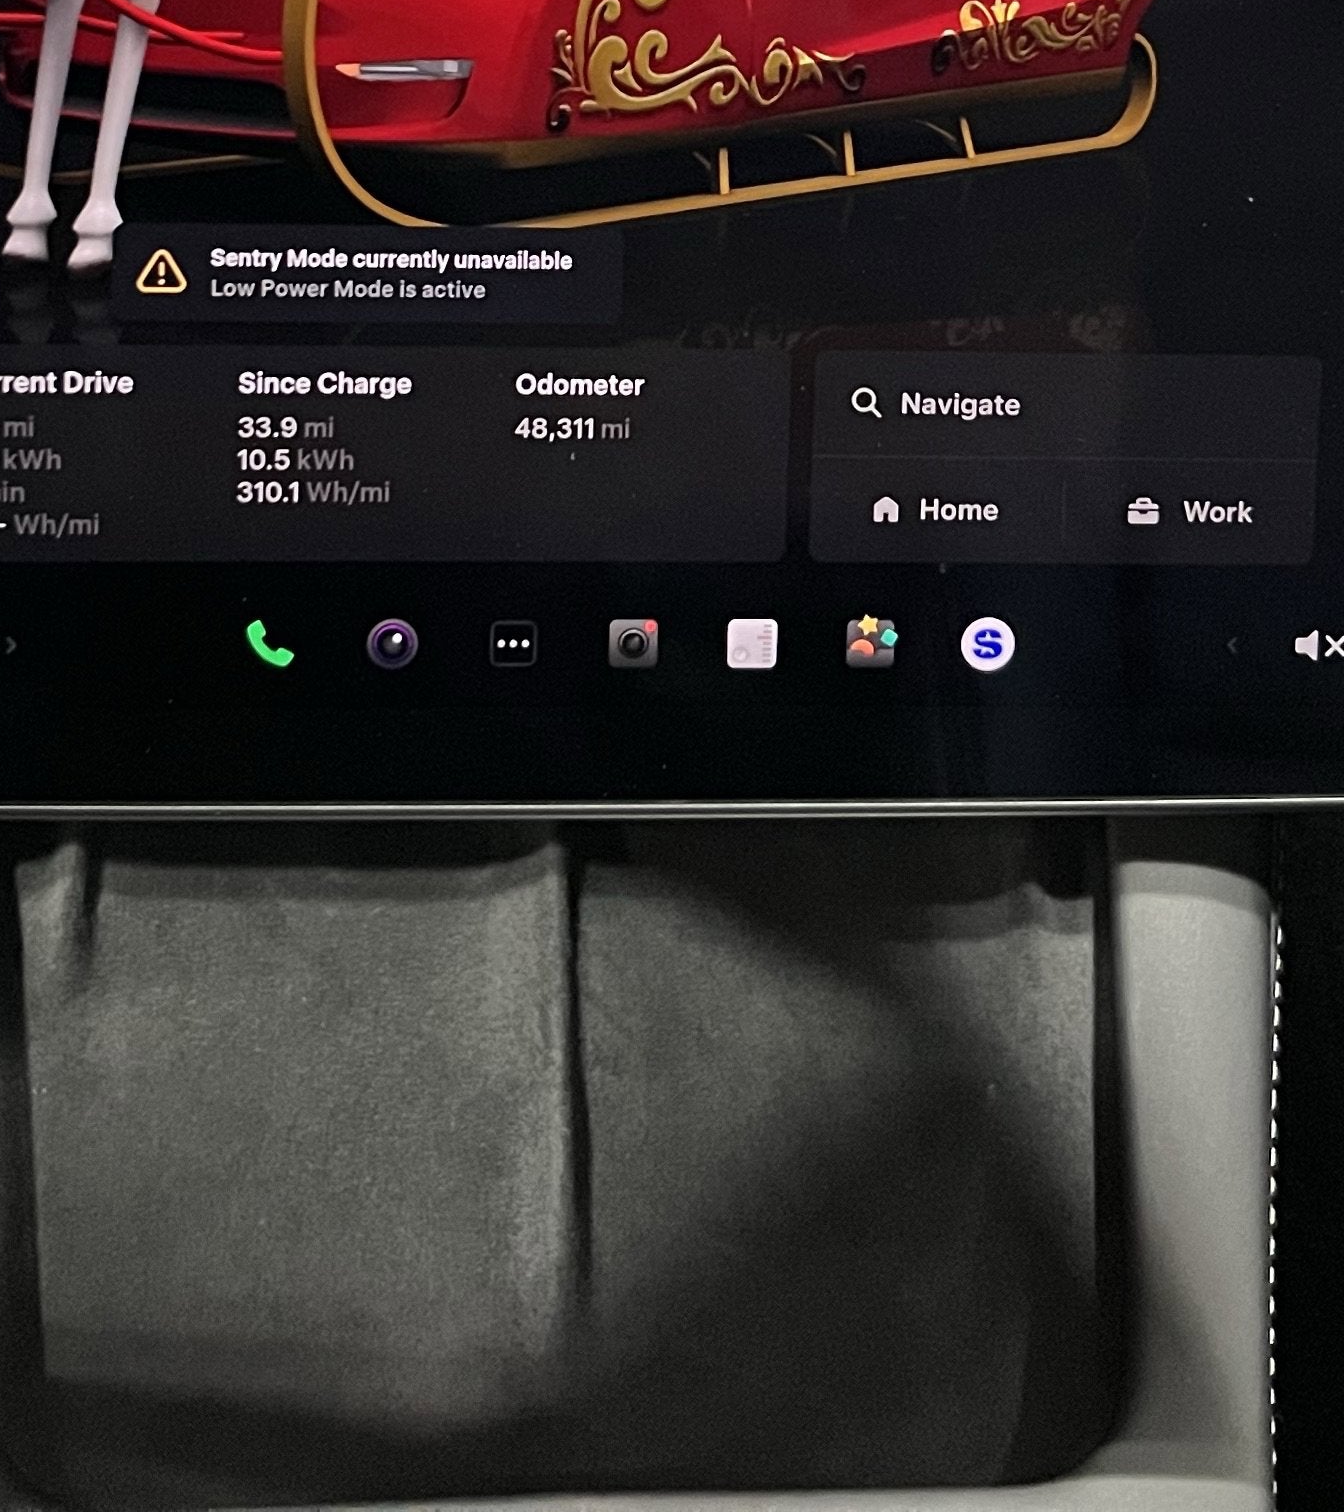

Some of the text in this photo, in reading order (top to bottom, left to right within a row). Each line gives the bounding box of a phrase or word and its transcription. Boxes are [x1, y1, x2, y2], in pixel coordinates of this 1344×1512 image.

[209, 247, 573, 274] Sentry Mode currently unavailable
[210, 278, 486, 299] Low Power Mode is active
[63, 370, 134, 395] Drive
[238, 370, 413, 400] Since Charge
[515, 372, 646, 397] Odometer
[901, 392, 1021, 421] Navigate
[3, 415, 34, 438] mi
[237, 415, 334, 439] 33.9 mi
[514, 417, 630, 443] 48,311 mi
[3, 448, 62, 470] kWh
[236, 447, 354, 471] 10.5 kWh
[236, 480, 390, 506] 310.1 Wh/mi
[920, 497, 999, 522] Home
[1183, 500, 1253, 524] Work
[13, 512, 100, 539] Wh/mi
